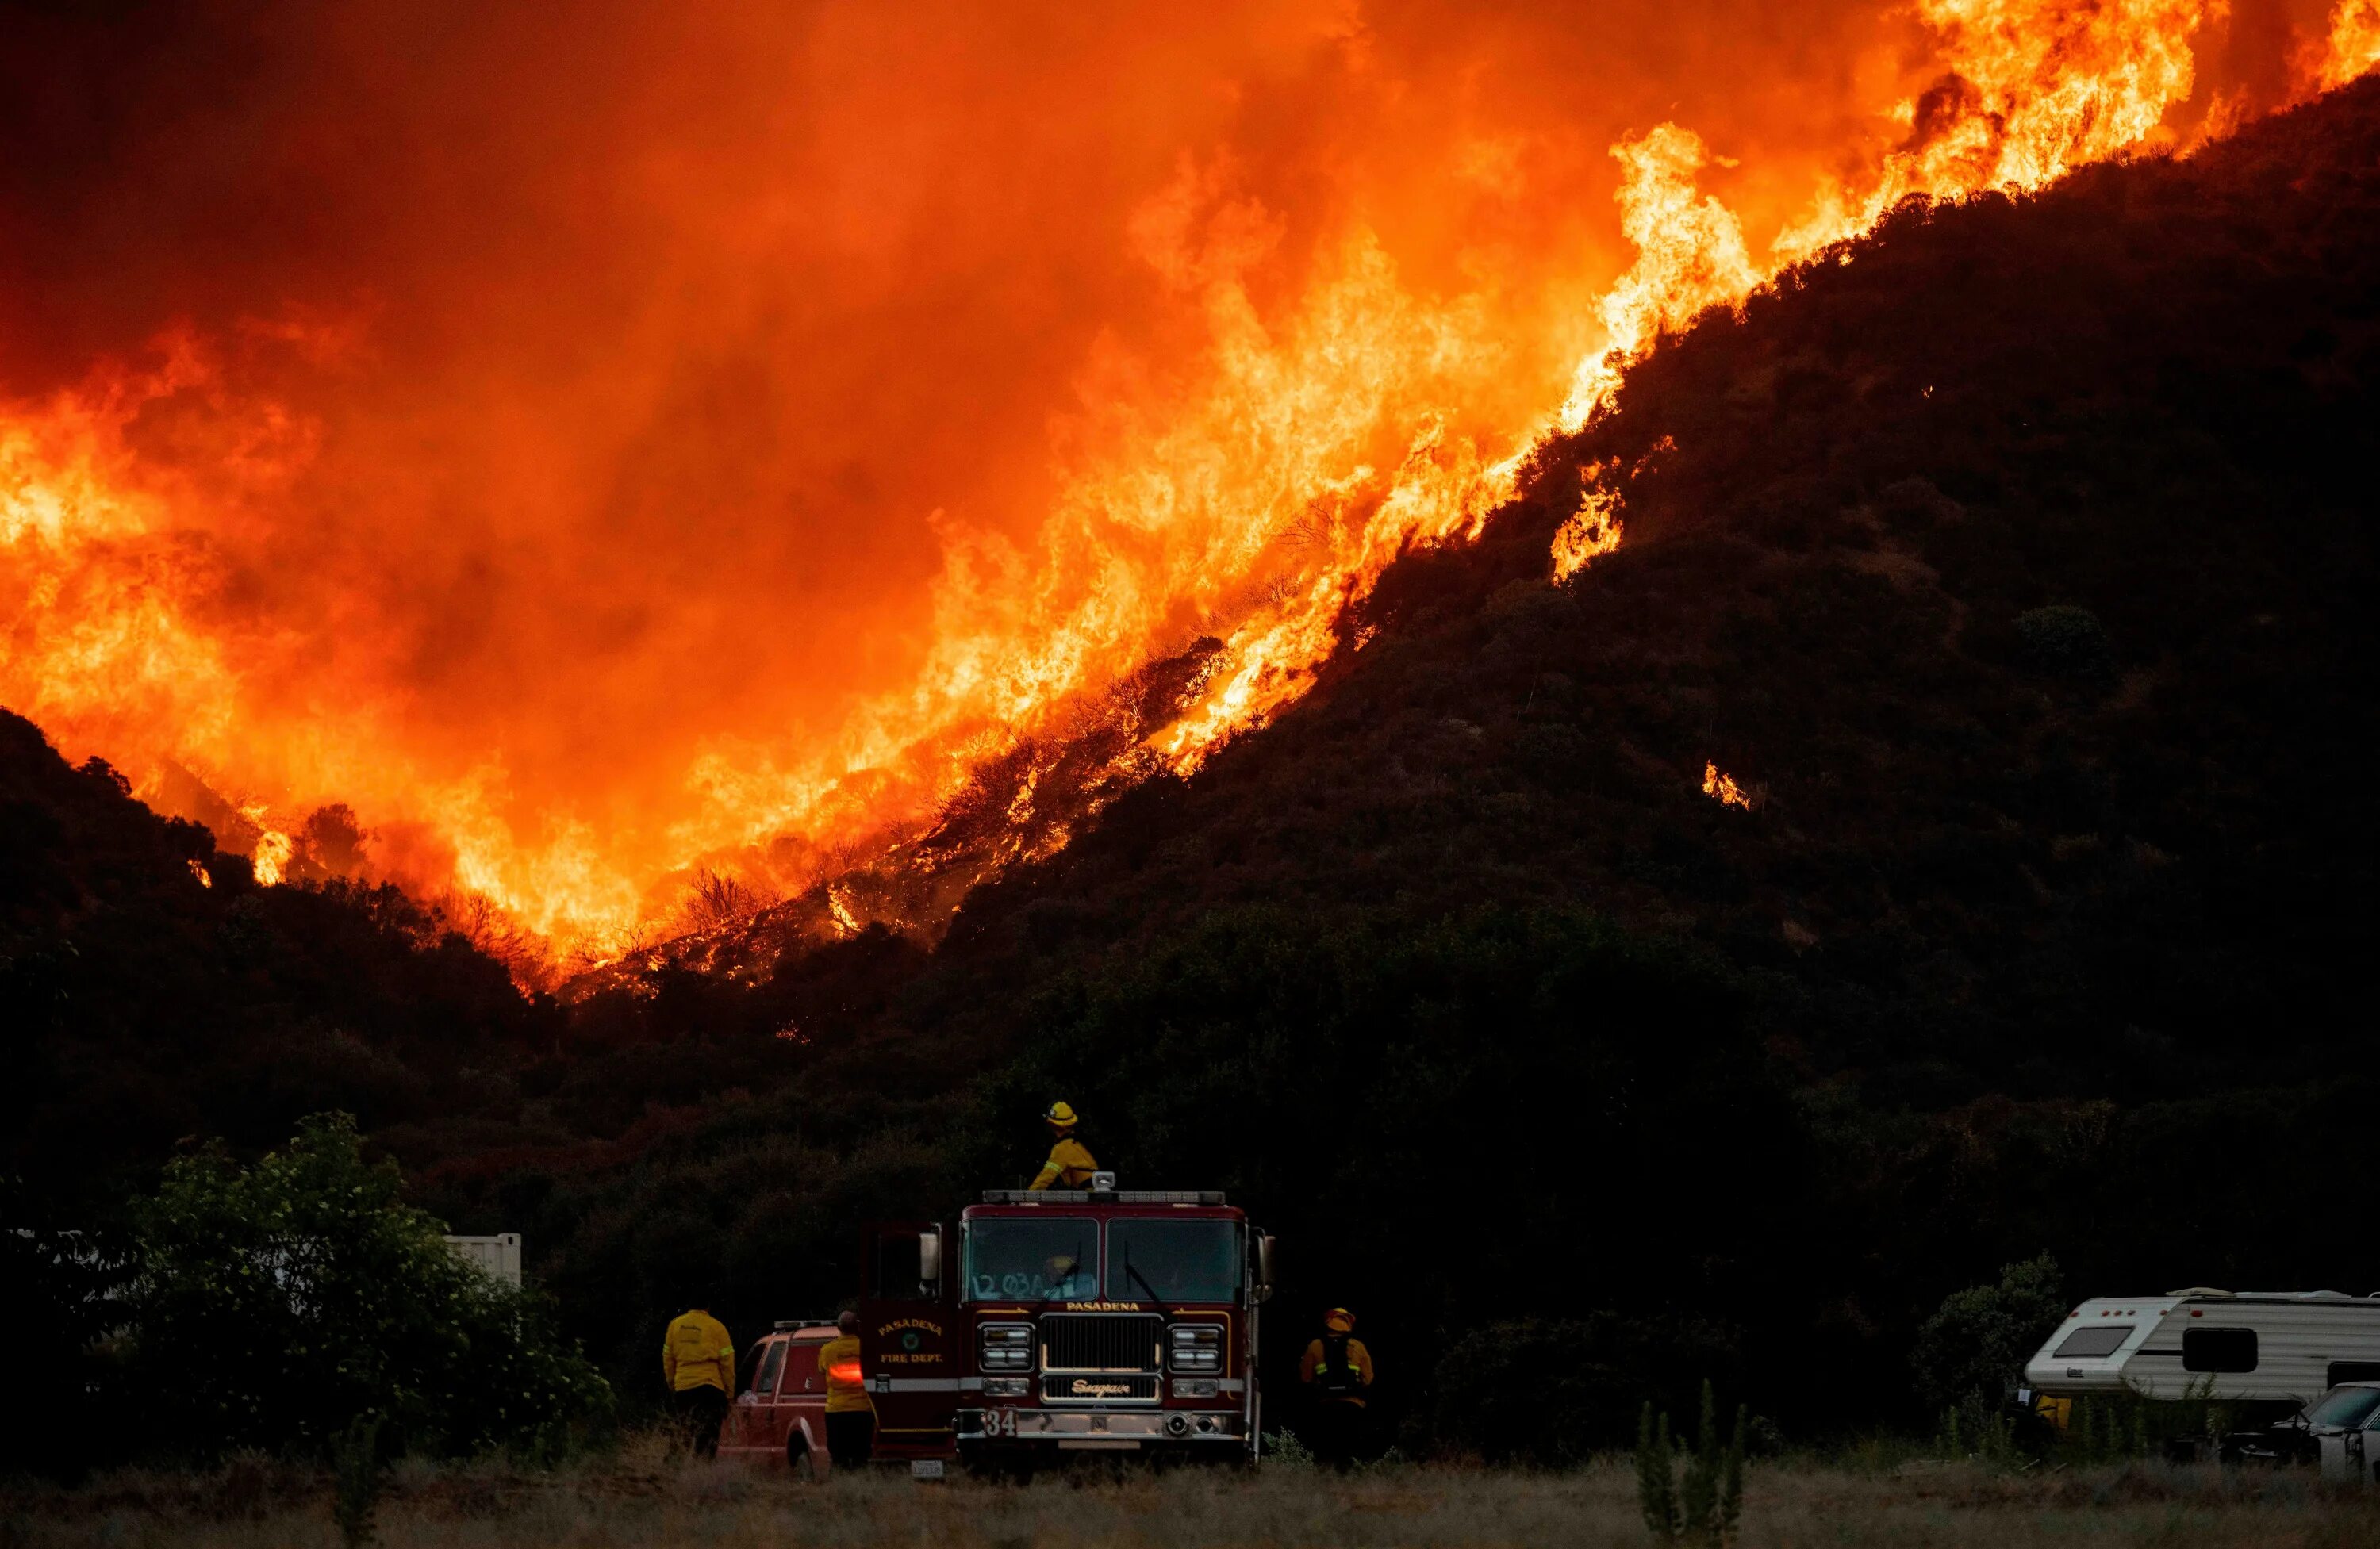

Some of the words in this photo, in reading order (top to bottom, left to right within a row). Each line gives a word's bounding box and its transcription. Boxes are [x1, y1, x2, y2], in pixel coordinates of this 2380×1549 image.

[1066, 1302, 1140, 1312] PASADENA
[877, 1318, 942, 1337] PASADENA
[881, 1353, 908, 1363] FIRE
[910, 1353, 944, 1363] DEPT.
[986, 1409, 1015, 1437] 34
